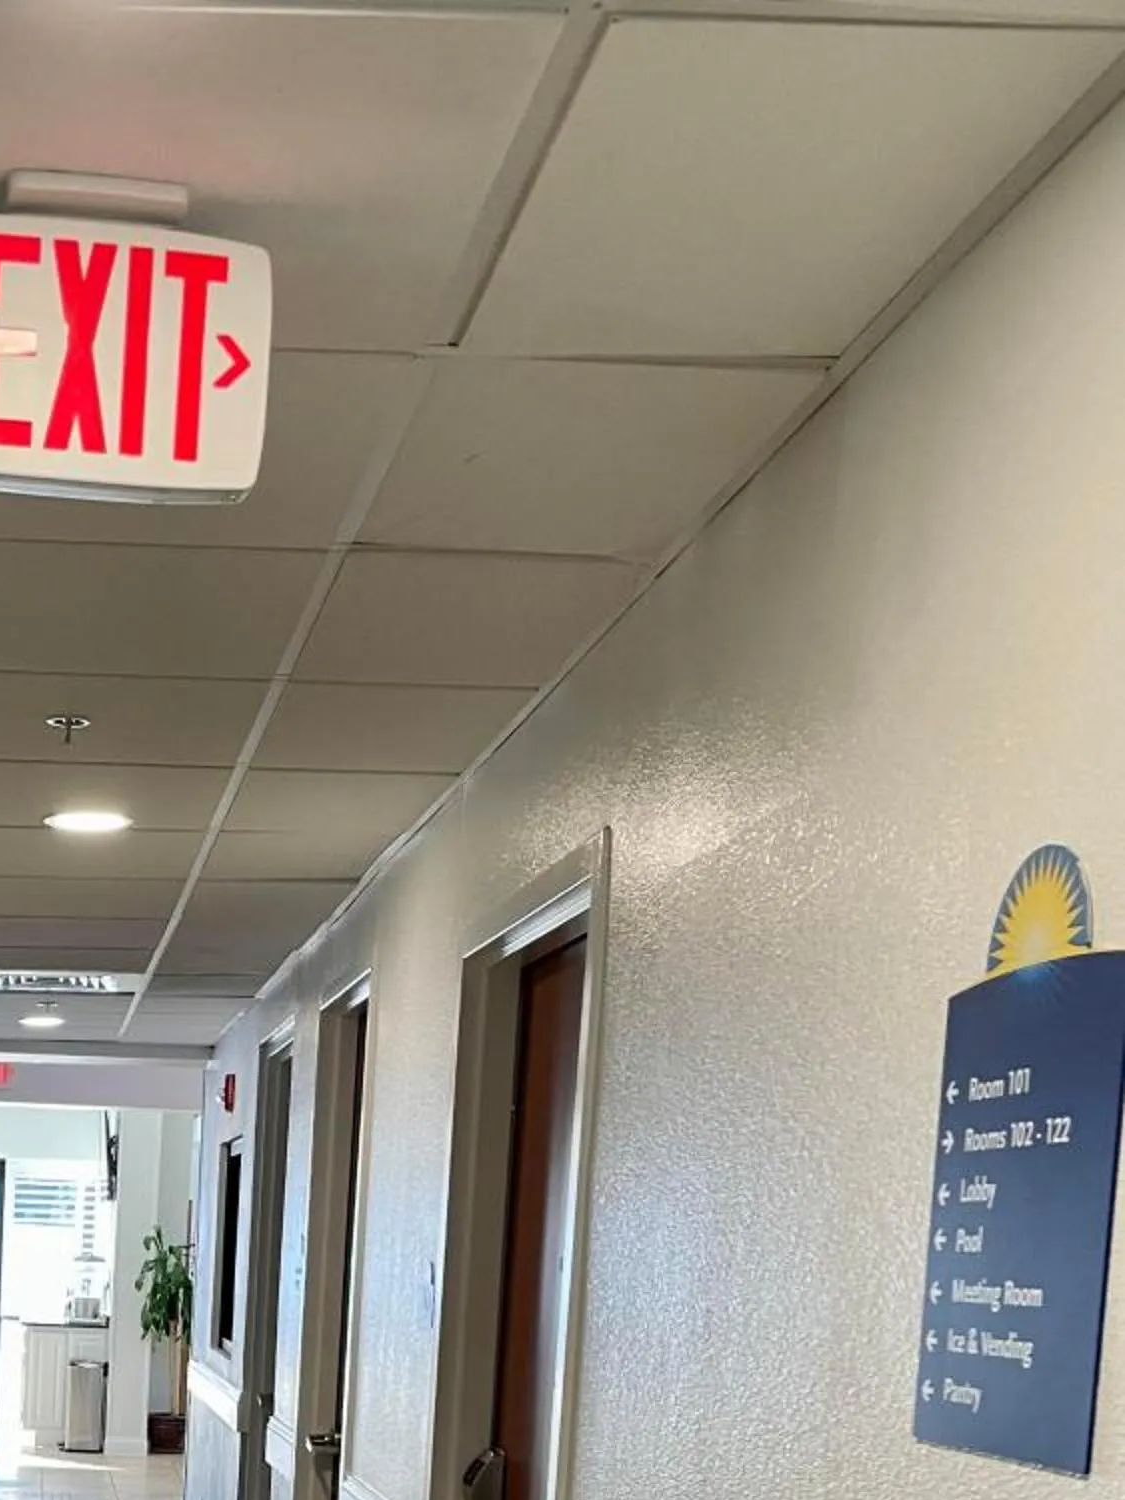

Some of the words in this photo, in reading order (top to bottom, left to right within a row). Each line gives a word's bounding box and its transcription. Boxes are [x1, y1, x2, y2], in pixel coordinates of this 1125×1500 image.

[968, 1077, 1004, 1102] Room
[1008, 1068, 1031, 1095] 101
[964, 1128, 1007, 1152] Rooms
[1010, 1121, 1034, 1147] 102
[1045, 1116, 1072, 1144] 122
[959, 1175, 997, 1209] Lobby
[955, 1226, 984, 1253] Pool
[952, 1278, 1002, 1312] Meeting
[1003, 1280, 1044, 1308] Room
[947, 1328, 966, 1353] Ice
[967, 1327, 978, 1354] &
[980, 1331, 1034, 1368] Vending
[943, 1378, 982, 1413] Pantry
